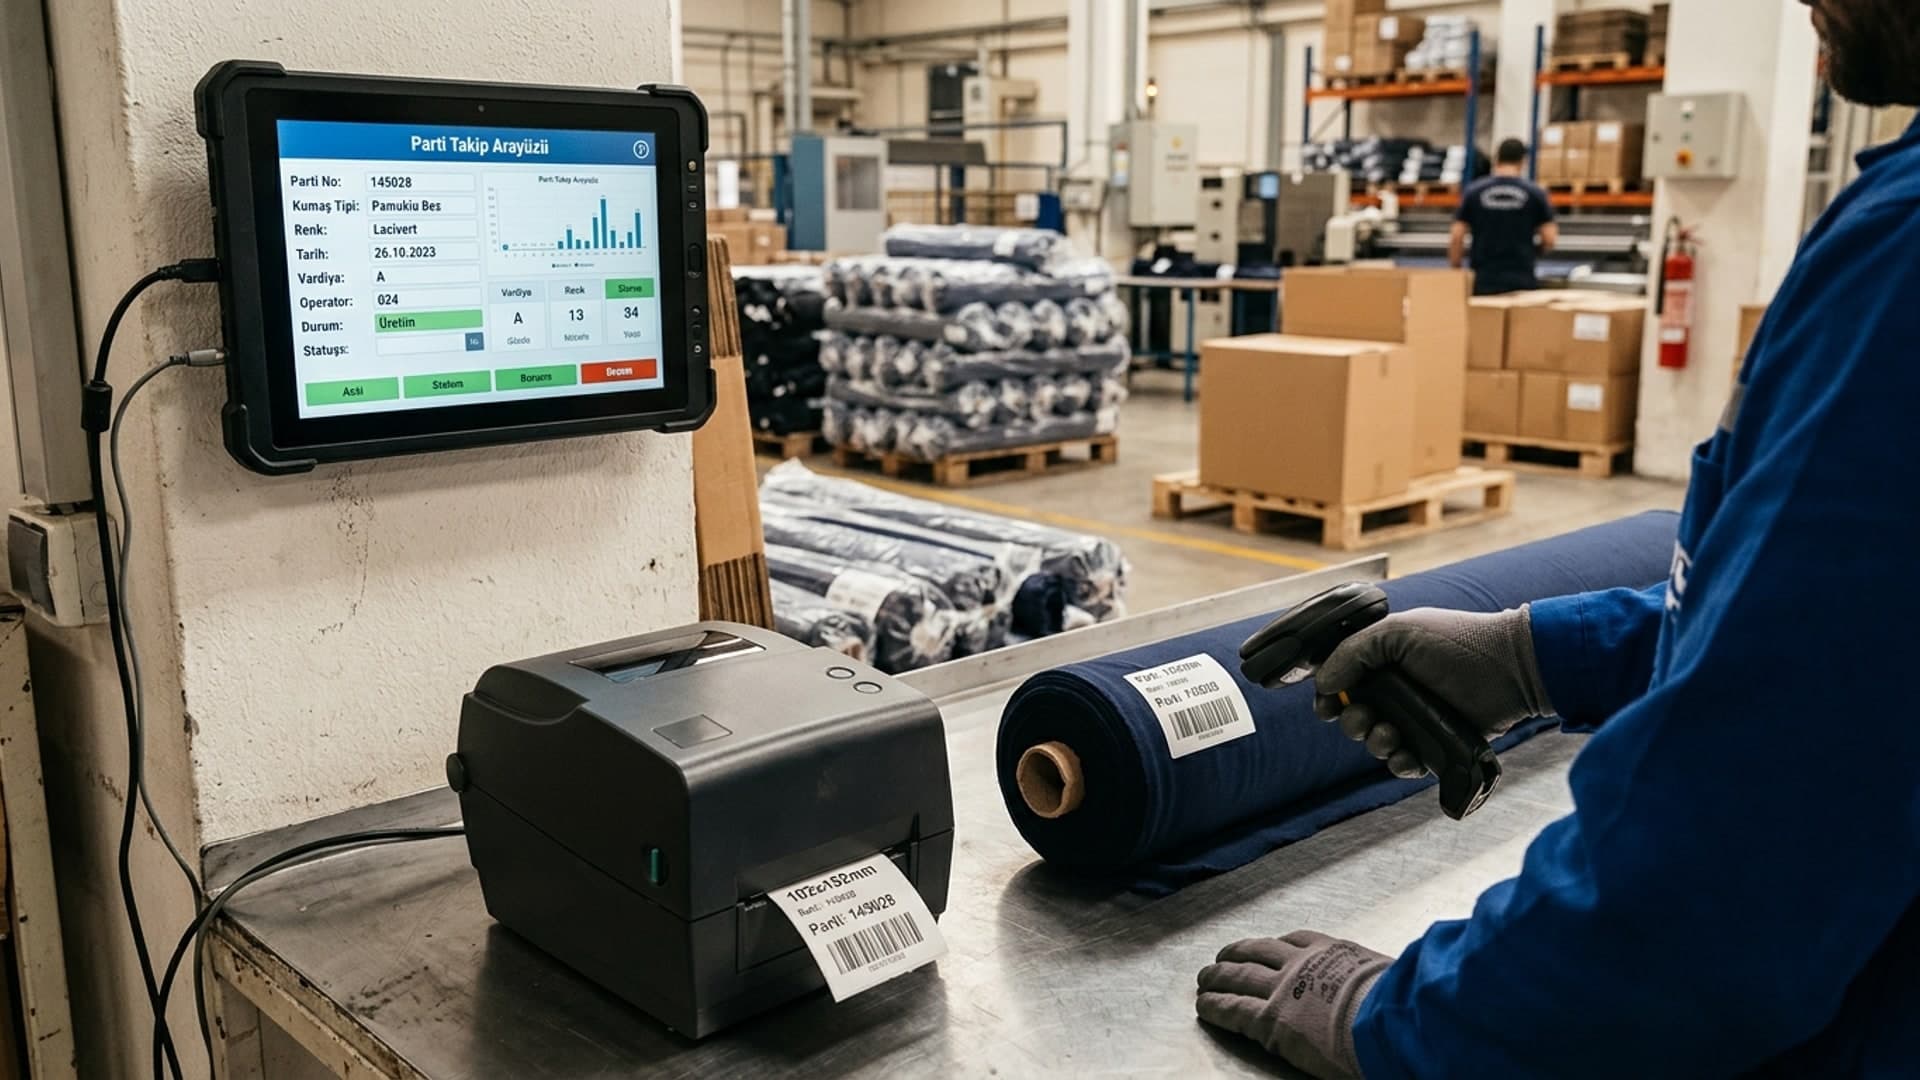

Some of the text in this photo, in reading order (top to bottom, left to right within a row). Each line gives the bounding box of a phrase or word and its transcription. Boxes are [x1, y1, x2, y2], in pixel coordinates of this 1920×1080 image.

[411, 136, 446, 151] Parti
[450, 137, 489, 156] Takip
[290, 175, 341, 187] Parti No:
[371, 176, 412, 188] 145028
[293, 200, 360, 214] Kumaş Tipi:
[294, 223, 327, 235] Renk:
[373, 223, 418, 235] Lacivert
[296, 248, 329, 260] Tarih:
[375, 247, 436, 259] 26.10.2023
[298, 272, 345, 286] Vardiya:
[376, 272, 385, 282] A
[300, 297, 353, 311] Operator:
[378, 294, 399, 305] 024
[513, 312, 524, 324] A
[569, 309, 584, 321] 13
[624, 306, 639, 319] 34
[301, 321, 343, 333] Durum:
